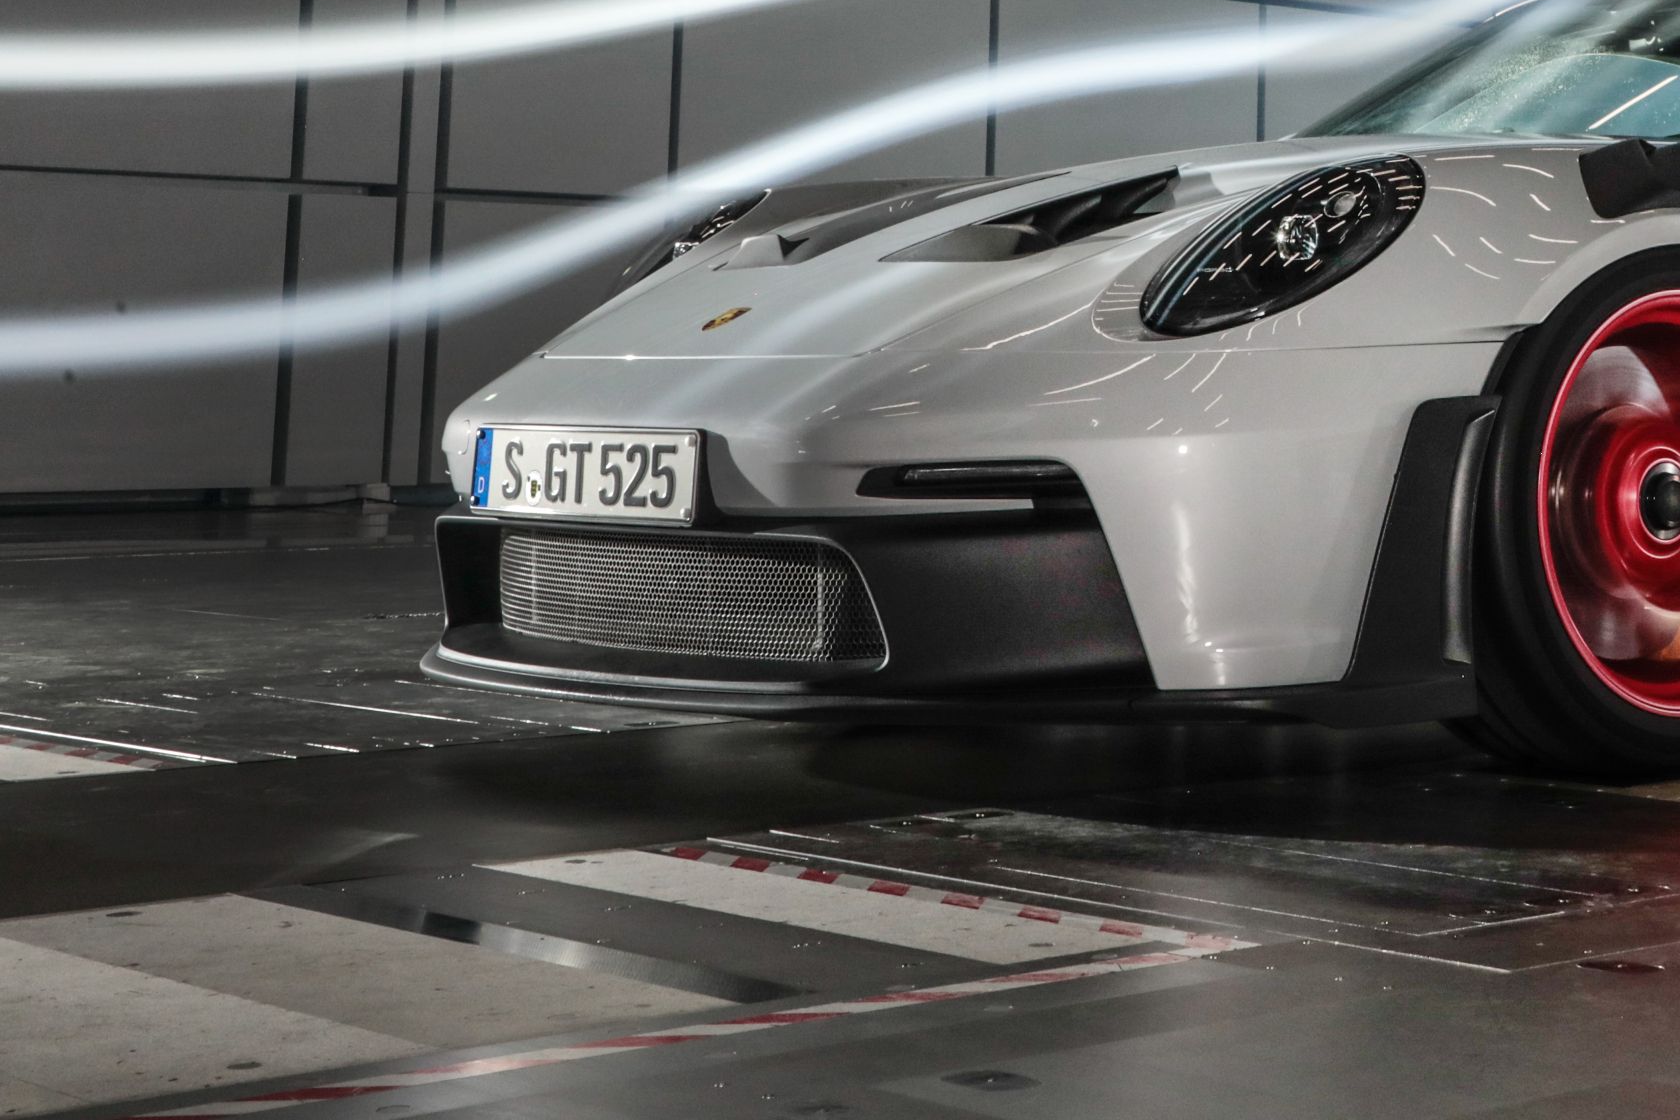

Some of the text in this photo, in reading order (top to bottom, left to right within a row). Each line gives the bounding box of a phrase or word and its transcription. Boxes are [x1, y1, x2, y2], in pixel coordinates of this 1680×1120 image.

[477, 476, 485, 494] D
[502, 439, 679, 508] S GT 525
